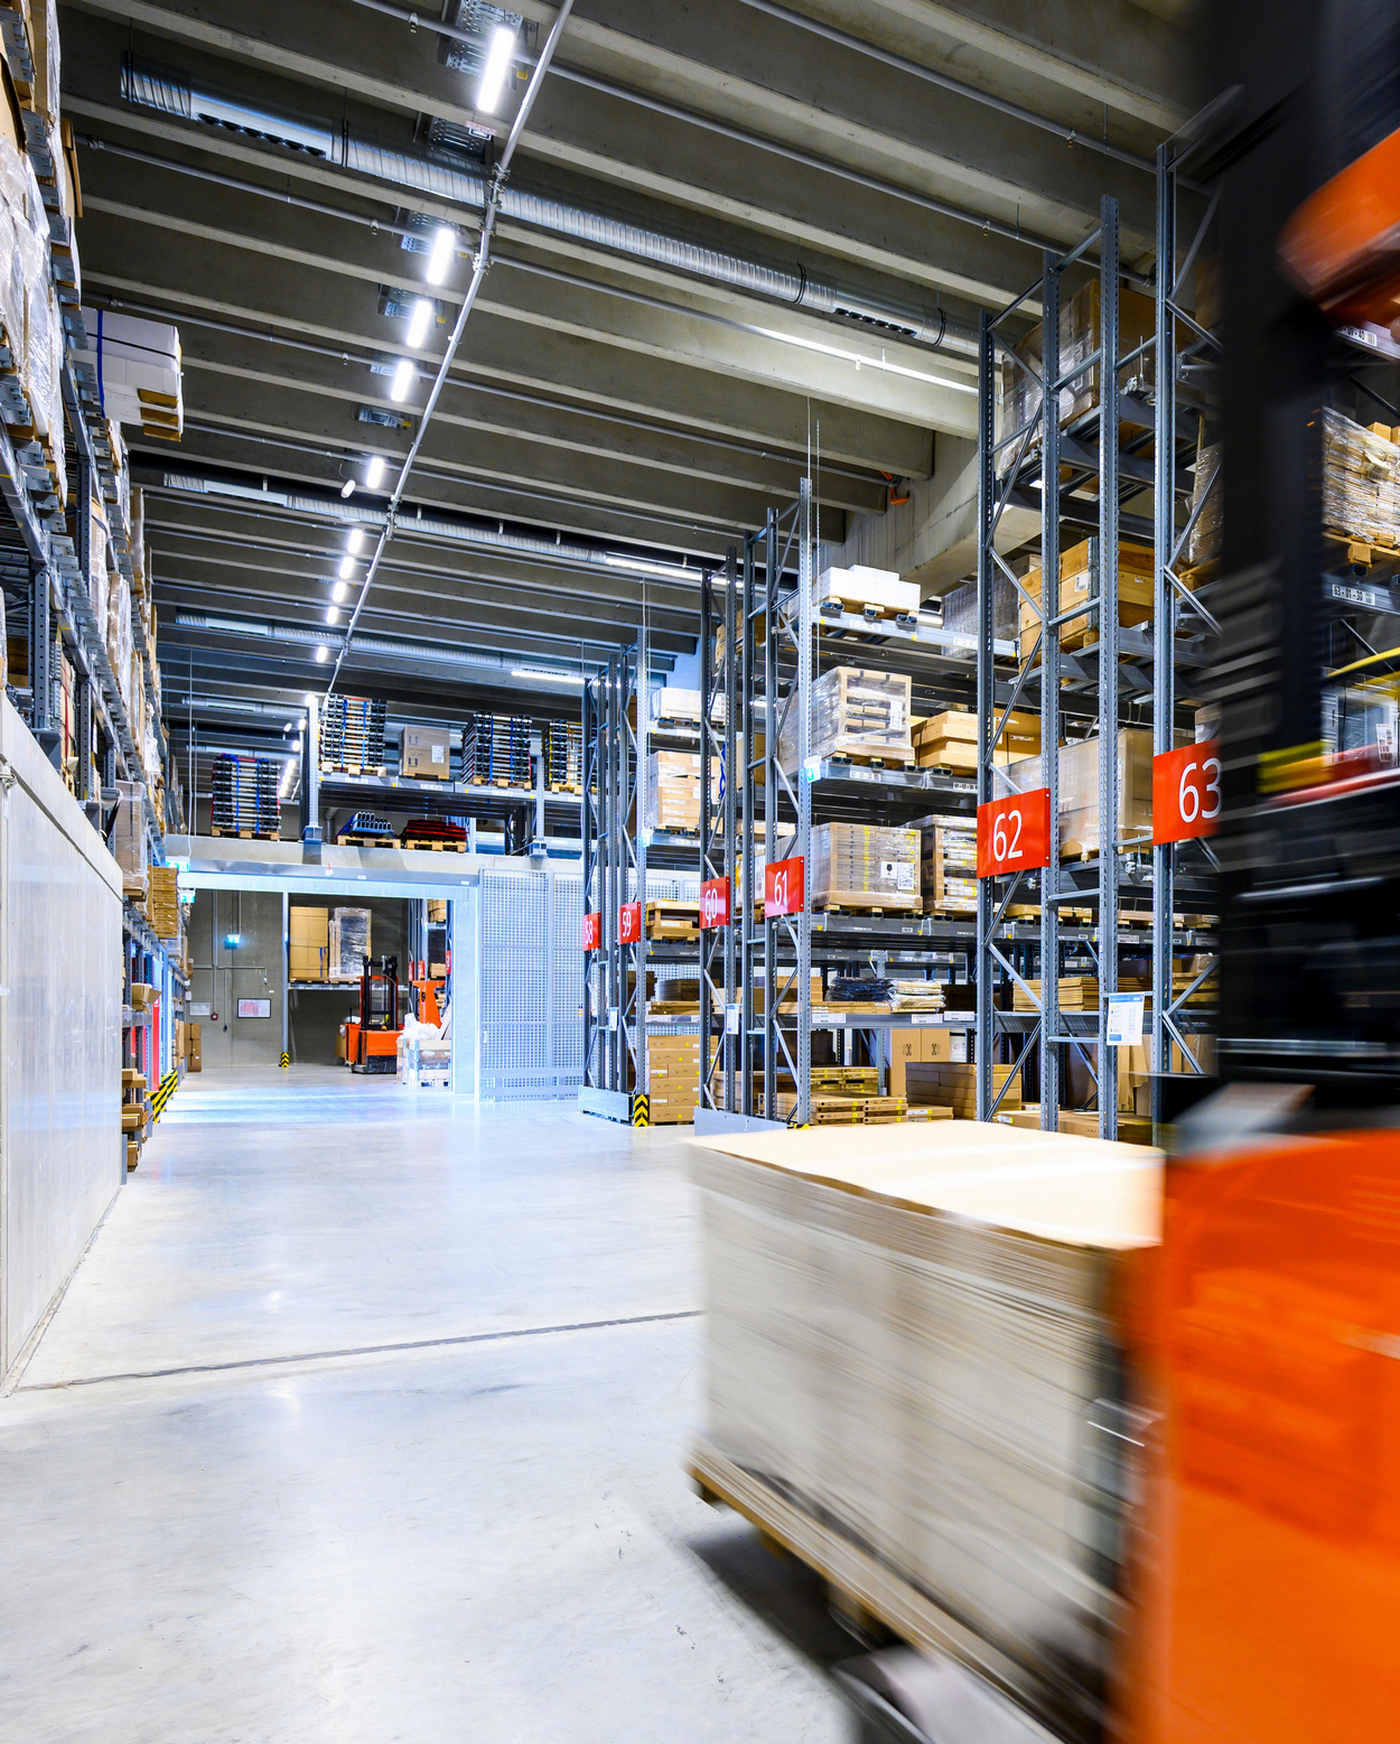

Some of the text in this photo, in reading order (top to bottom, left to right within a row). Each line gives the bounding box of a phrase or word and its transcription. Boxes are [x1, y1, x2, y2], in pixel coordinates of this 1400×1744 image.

[1179, 757, 1222, 823] 63
[992, 809, 1023, 862] 62
[705, 887, 718, 921] 60
[774, 869, 788, 907] 61
[585, 920, 594, 945] 58
[622, 910, 632, 937] 59
